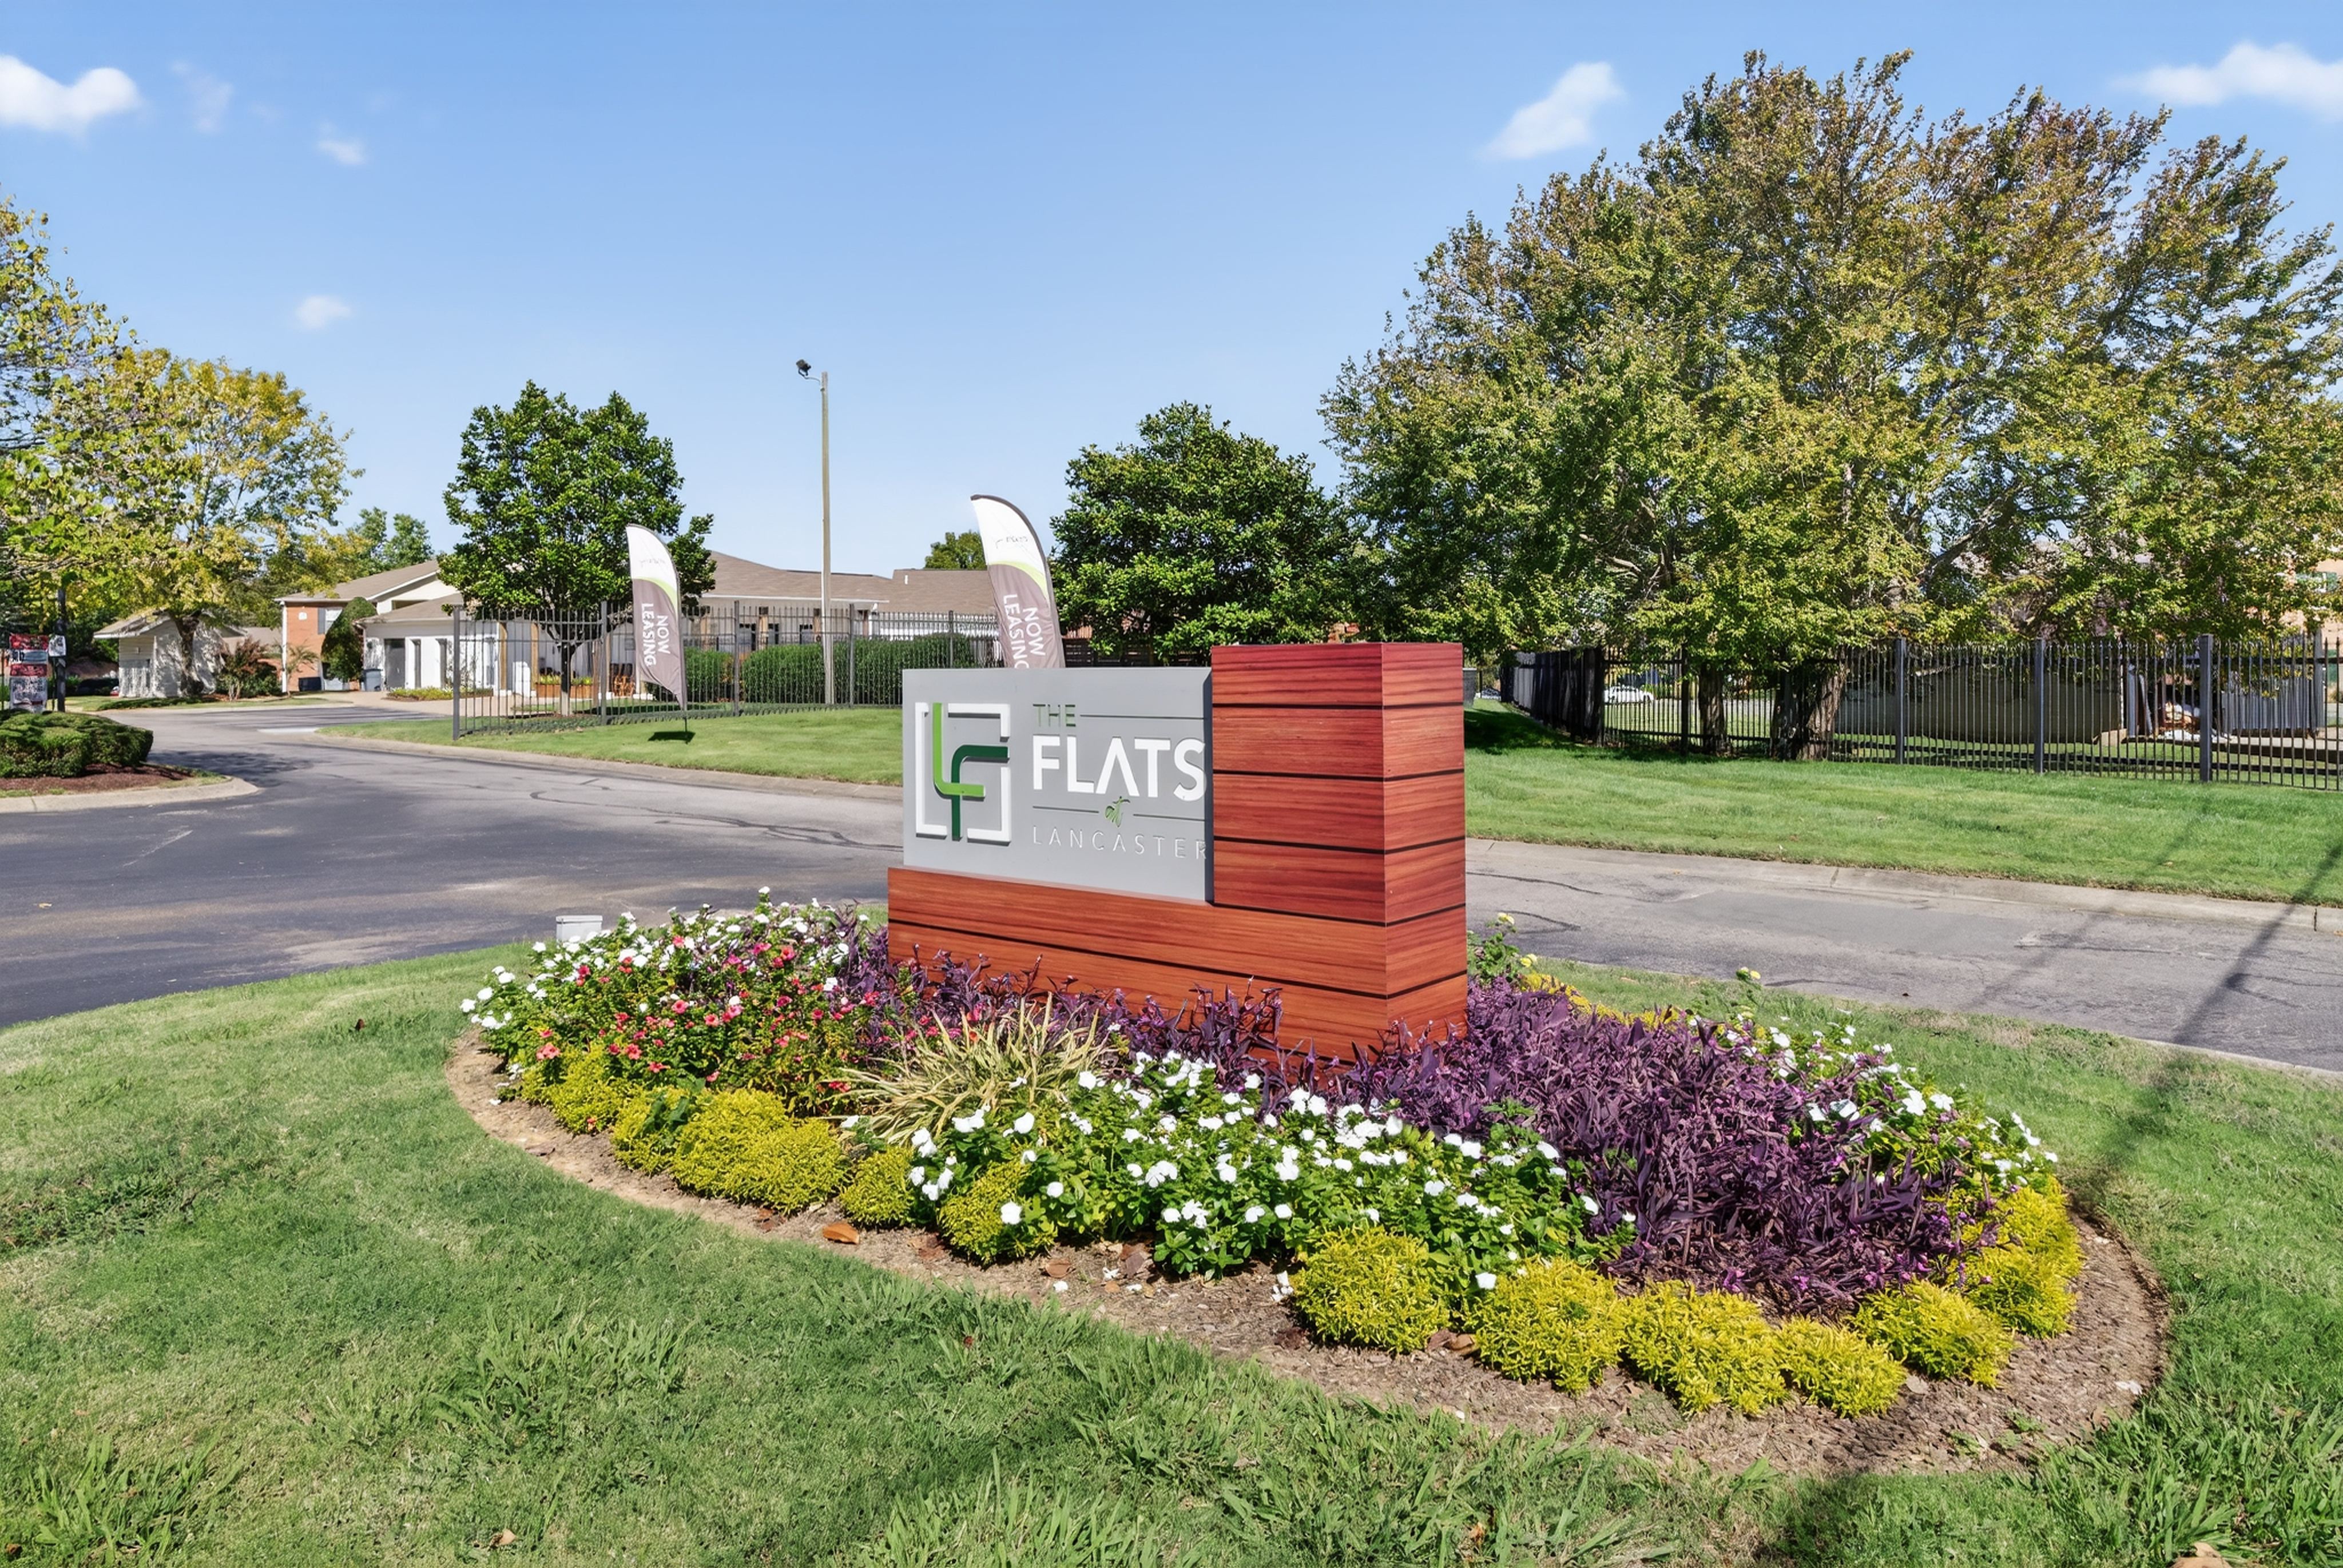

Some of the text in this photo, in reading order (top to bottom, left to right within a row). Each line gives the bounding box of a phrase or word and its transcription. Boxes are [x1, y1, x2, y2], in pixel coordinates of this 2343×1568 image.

[641, 603, 657, 667] LEASING
[657, 614, 670, 654] NOW
[1022, 607, 1046, 656] NOW
[1032, 704, 1077, 727] THE
[1032, 734, 1207, 801] FLATS
[1032, 826, 1206, 859] LANCASTER
